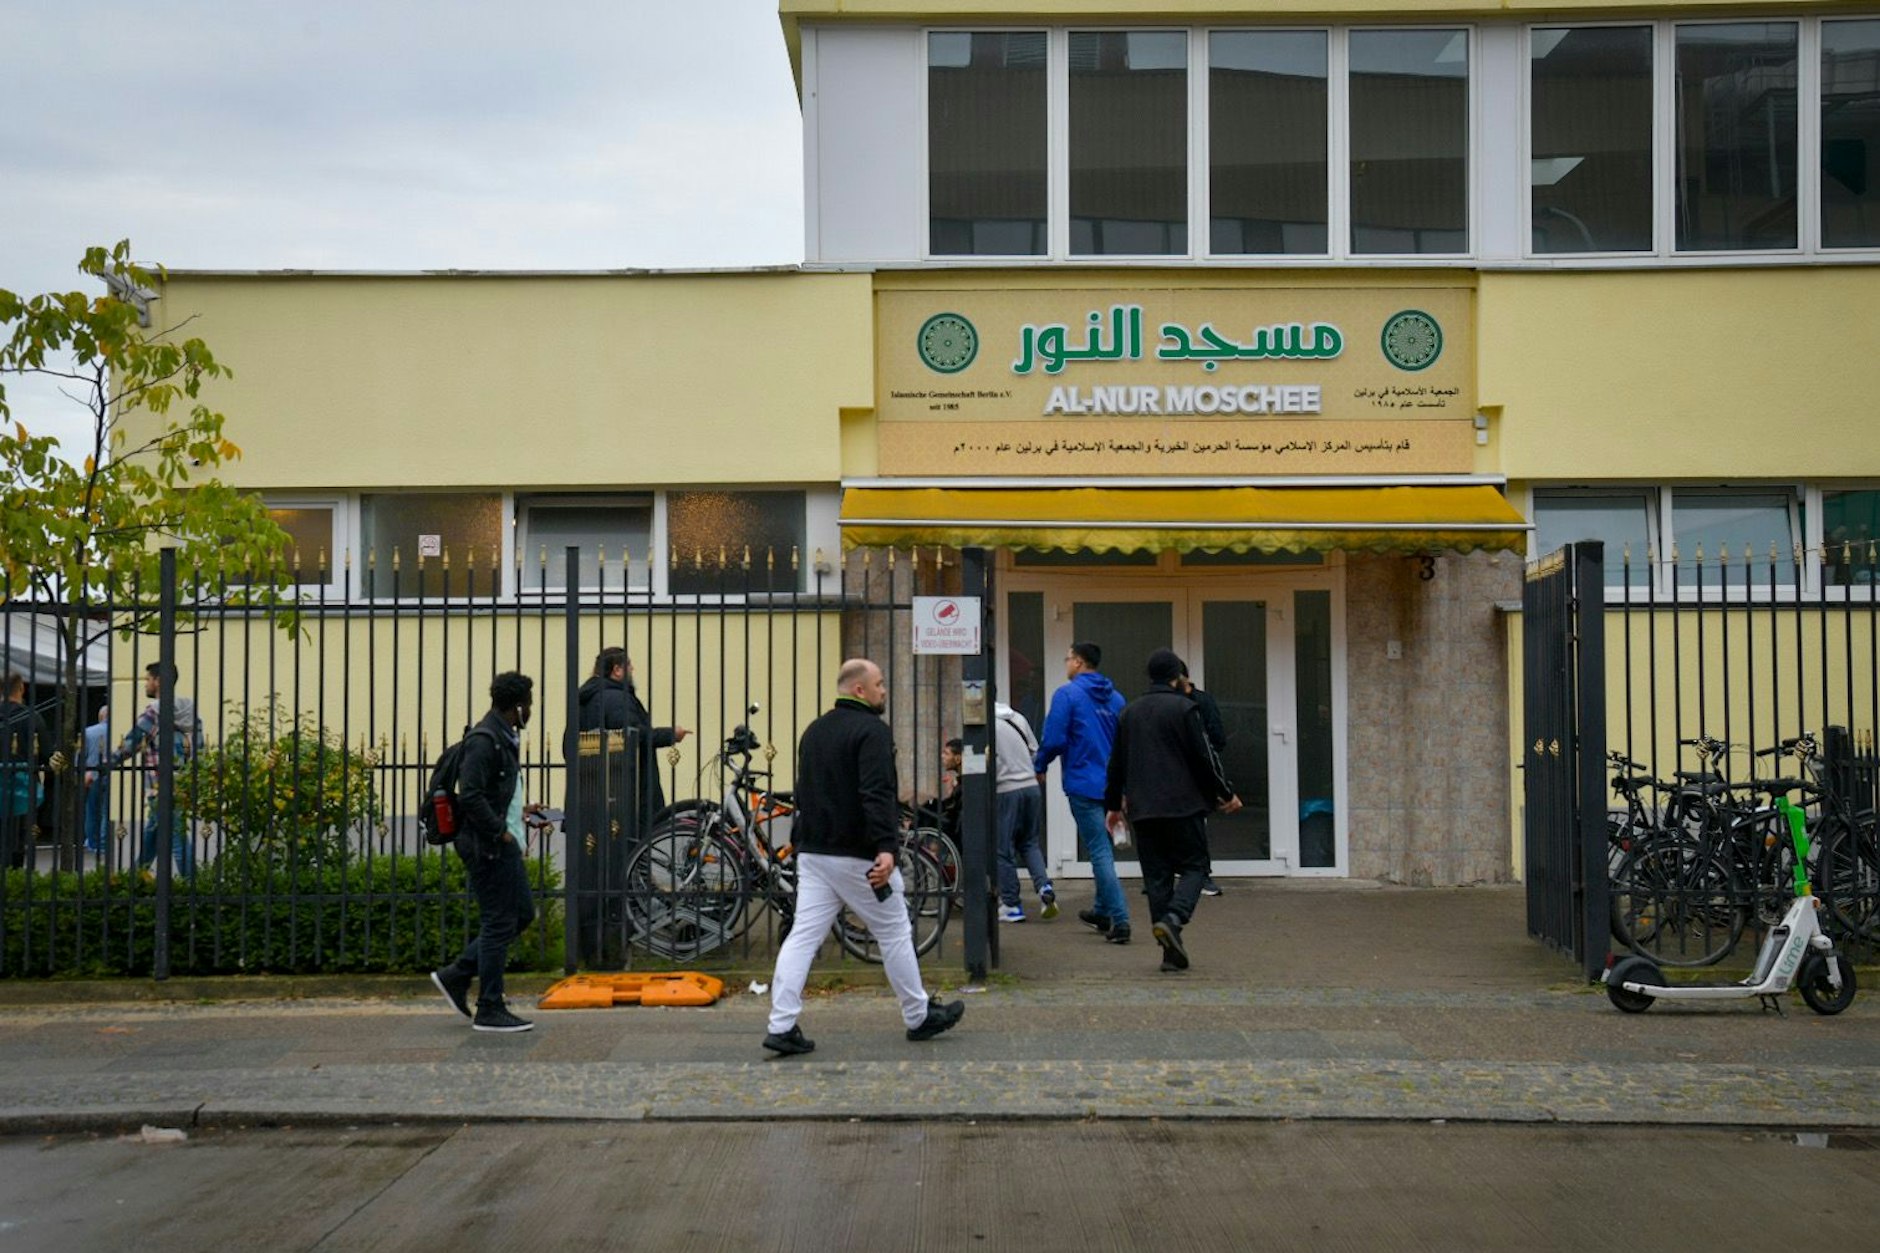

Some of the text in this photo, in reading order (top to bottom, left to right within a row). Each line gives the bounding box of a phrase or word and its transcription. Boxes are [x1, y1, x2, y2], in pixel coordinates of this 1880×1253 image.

[1011, 305, 1343, 374] مسجد النور
[890, 390, 927, 398] Islamische
[929, 390, 975, 398] Gemeinschaft
[977, 390, 998, 398] Berlin
[1045, 384, 1321, 414] AL-NUR MOSCHEE
[1353, 387, 1376, 398] برلين
[1377, 386, 1390, 399] في
[1429, 386, 1460, 398] الجمعية
[929, 403, 941, 411] seit
[994, 442, 1012, 455] عام
[1015, 440, 1043, 455] برلين
[1044, 439, 1060, 456] في
[1108, 438, 1152, 455] والجمعية
[1153, 438, 1190, 455] الخيرية
[1191, 440, 1232, 454] الحرمين
[1234, 438, 1272, 454] مؤسسة
[1320, 439, 1352, 454] المركز
[1395, 438, 1411, 454] قام
[1420, 556, 1435, 580] 3
[1778, 936, 1804, 975] Lime
